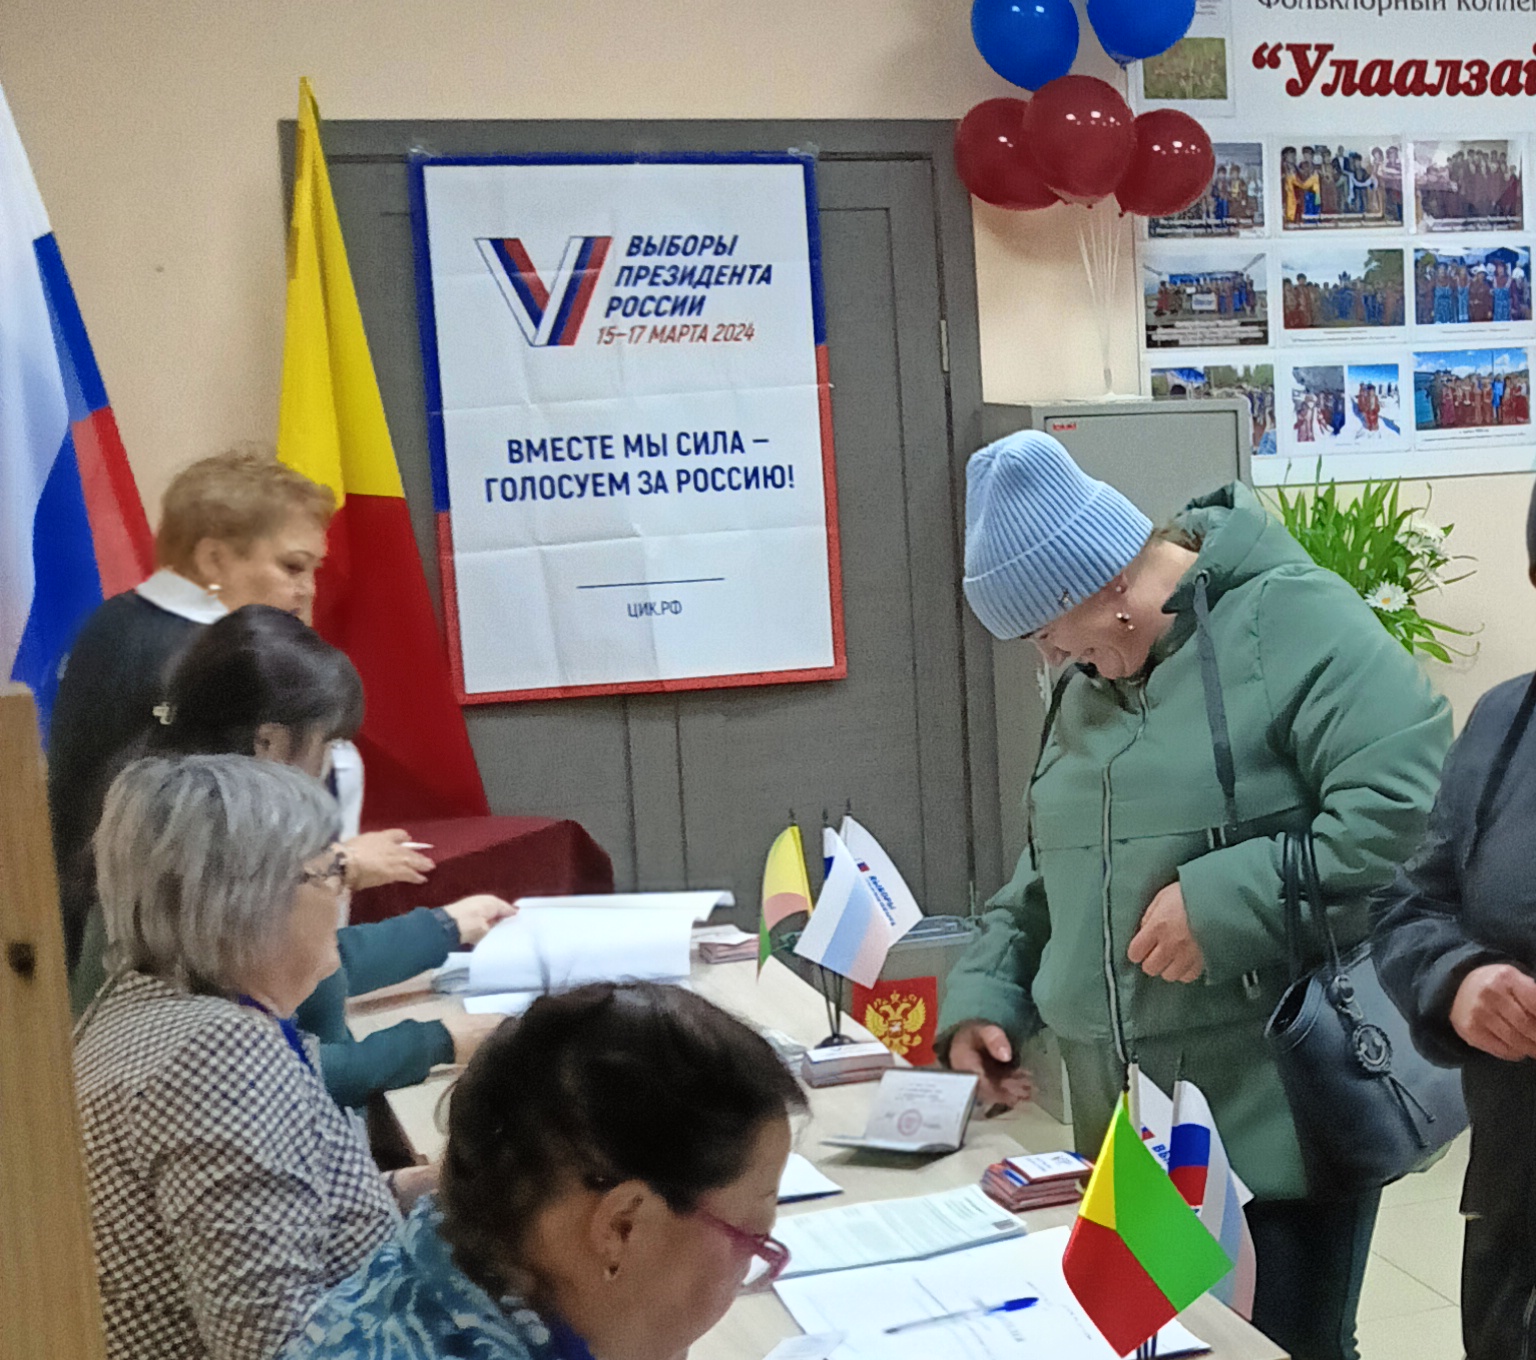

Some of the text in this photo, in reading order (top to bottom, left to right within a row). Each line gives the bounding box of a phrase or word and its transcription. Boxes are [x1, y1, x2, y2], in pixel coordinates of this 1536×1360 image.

[626, 235, 739, 257] ВЫБОРЫ
[615, 264, 773, 288] ПРЕЗИДЕНТА
[604, 295, 707, 319] РОССИИ
[651, 324, 708, 343] МАРТА
[712, 322, 756, 342] 2024
[507, 435, 616, 464] ВМЕСТЕ
[623, 433, 669, 459] МЫ
[676, 430, 746, 456] СИЛА
[485, 464, 796, 503] ГОЛОСУЕМ ЗА РОССИЮ!
[627, 600, 683, 619] ЦИК.РФ
